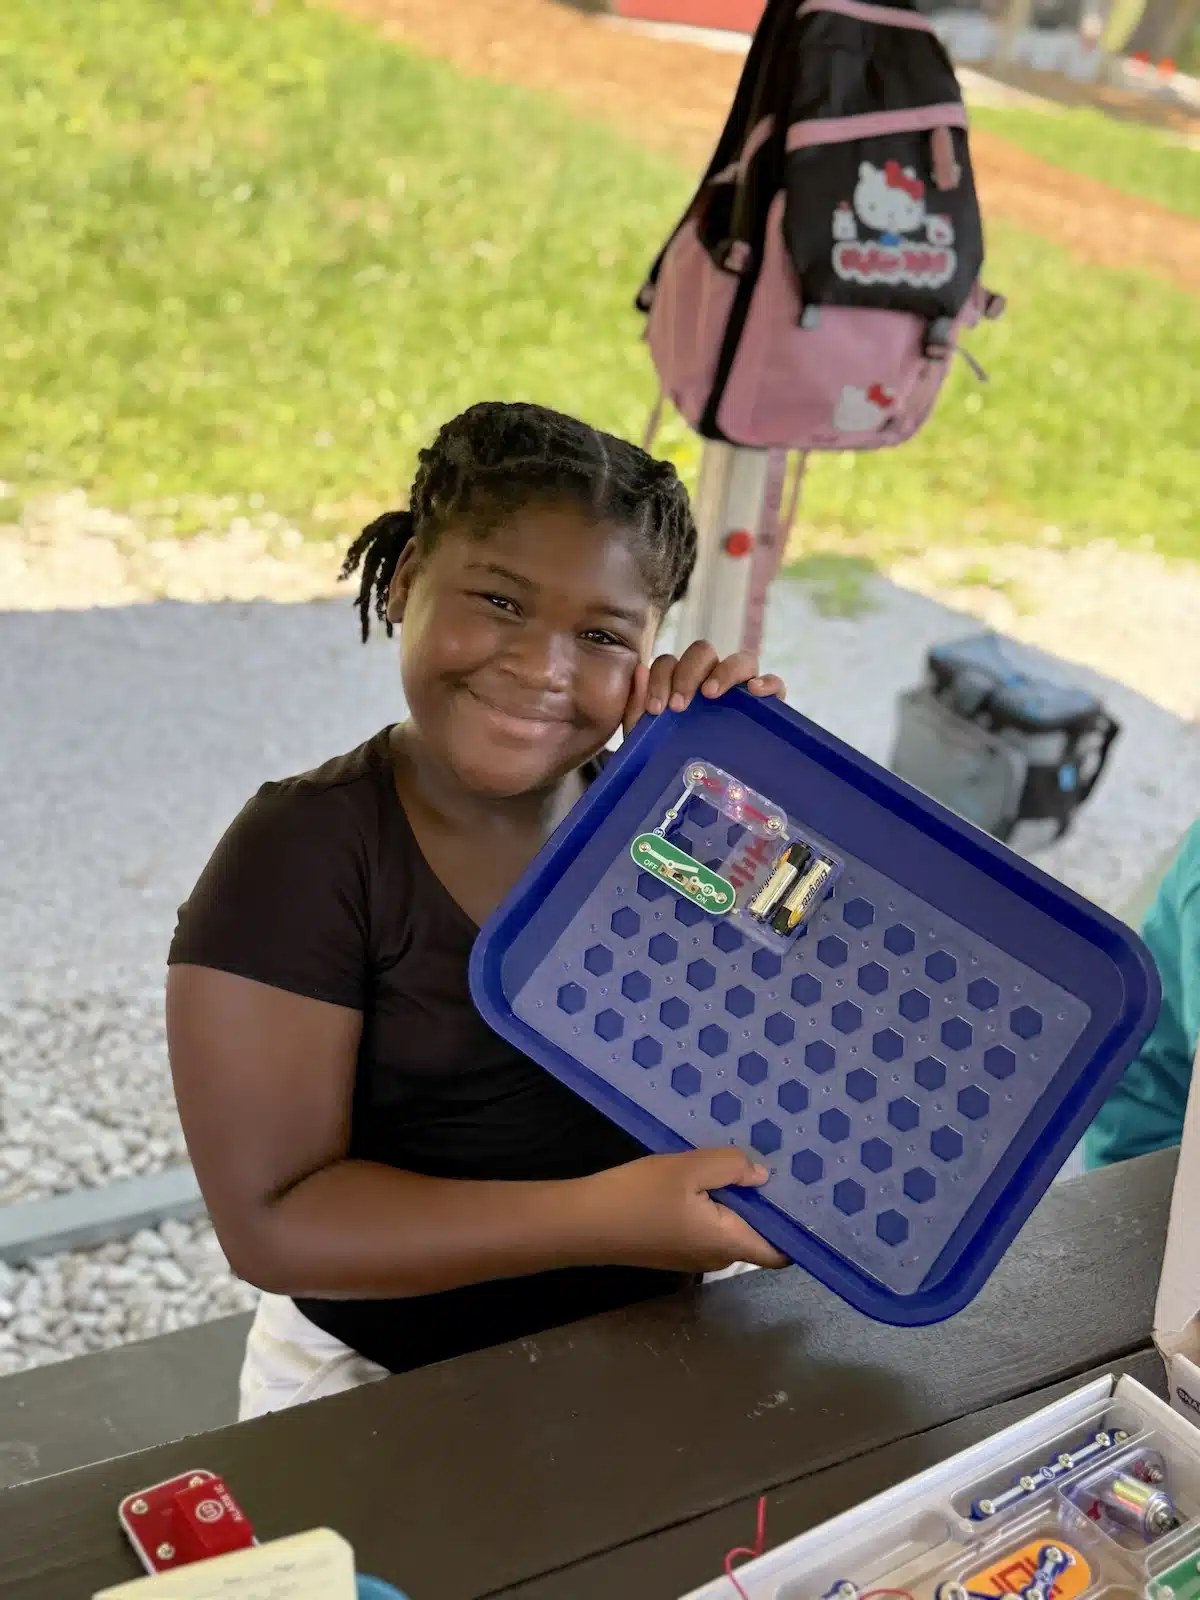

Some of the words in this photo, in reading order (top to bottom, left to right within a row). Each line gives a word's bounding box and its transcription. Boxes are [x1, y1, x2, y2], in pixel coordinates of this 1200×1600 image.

[643, 858, 660, 871] OFF
[801, 869, 829, 910] Energizer
[696, 893, 708, 905] ON
[1178, 1389, 1200, 1412] SNA
